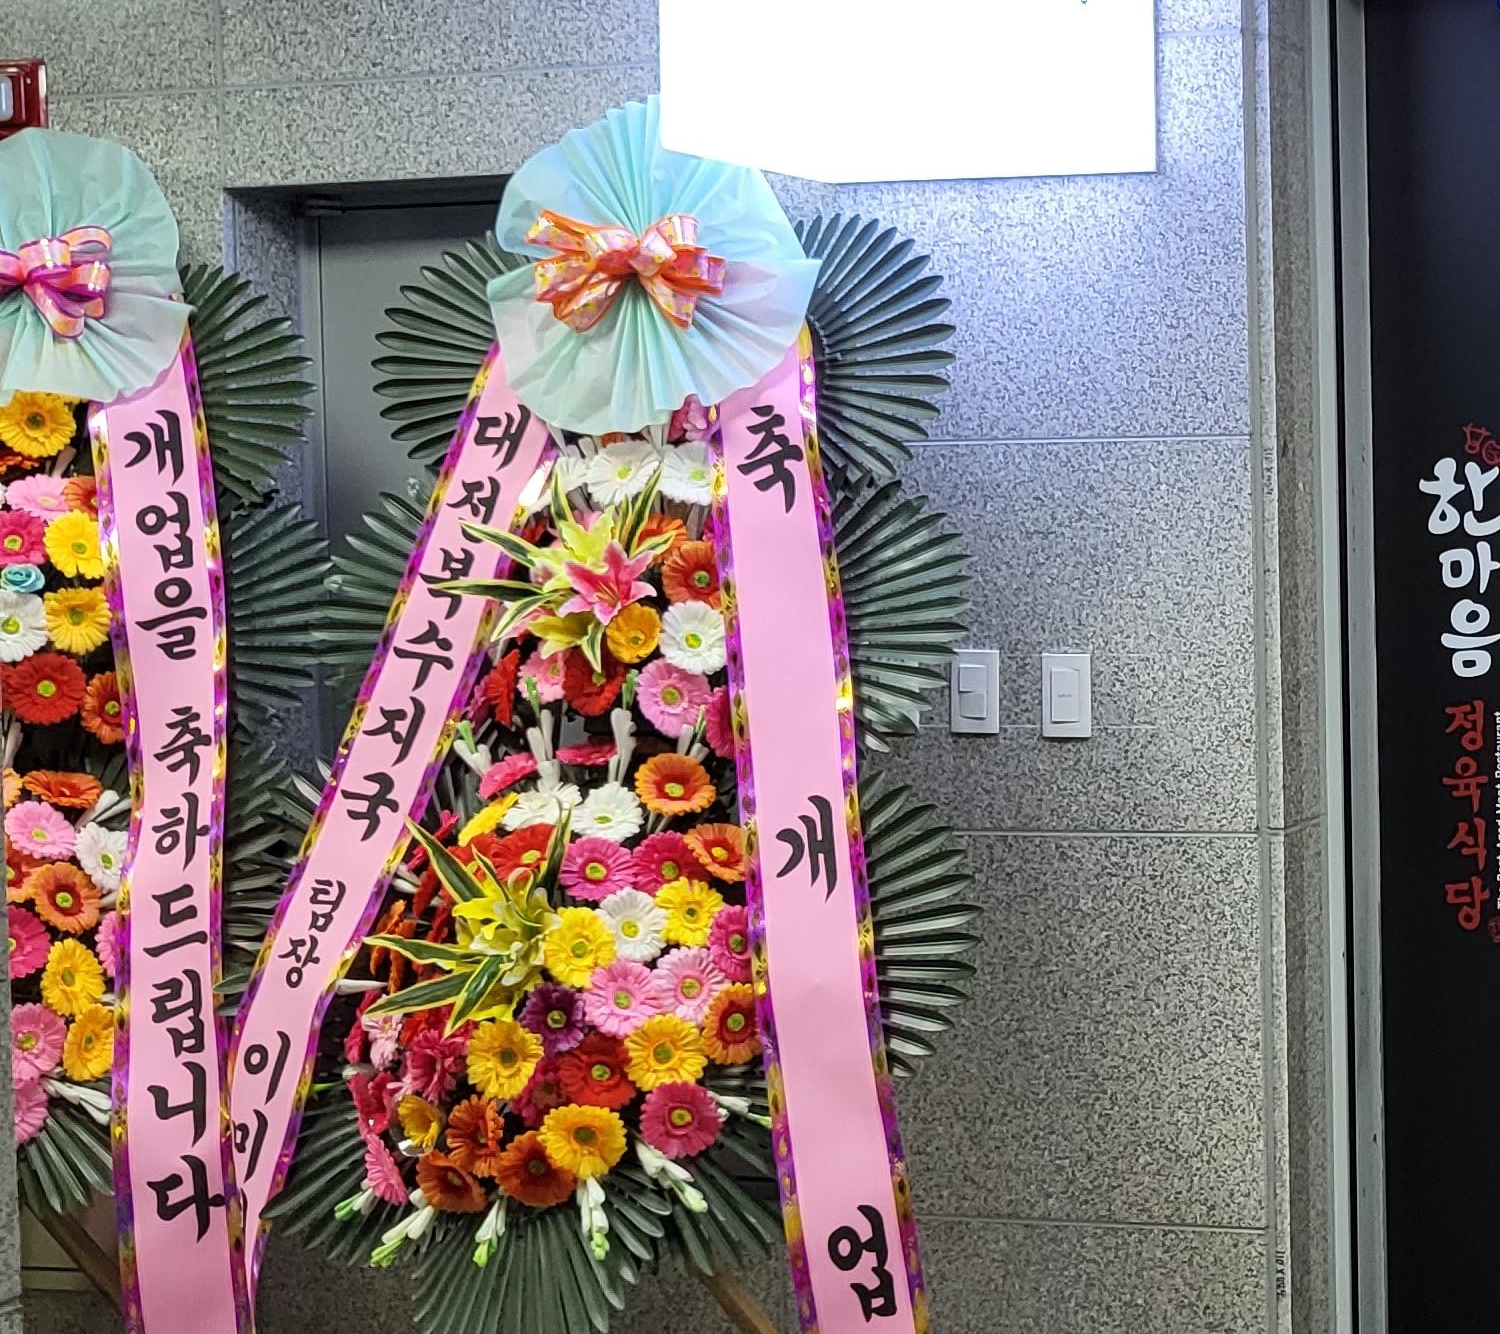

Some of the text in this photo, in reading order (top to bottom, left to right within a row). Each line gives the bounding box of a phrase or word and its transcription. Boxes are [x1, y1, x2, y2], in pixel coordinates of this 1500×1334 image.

[738, 404, 803, 517] 축
[123, 409, 226, 1243] 개업을 축하드립니다
[1442, 699, 1490, 931] 정육식당
[277, 877, 348, 991] 팀장
